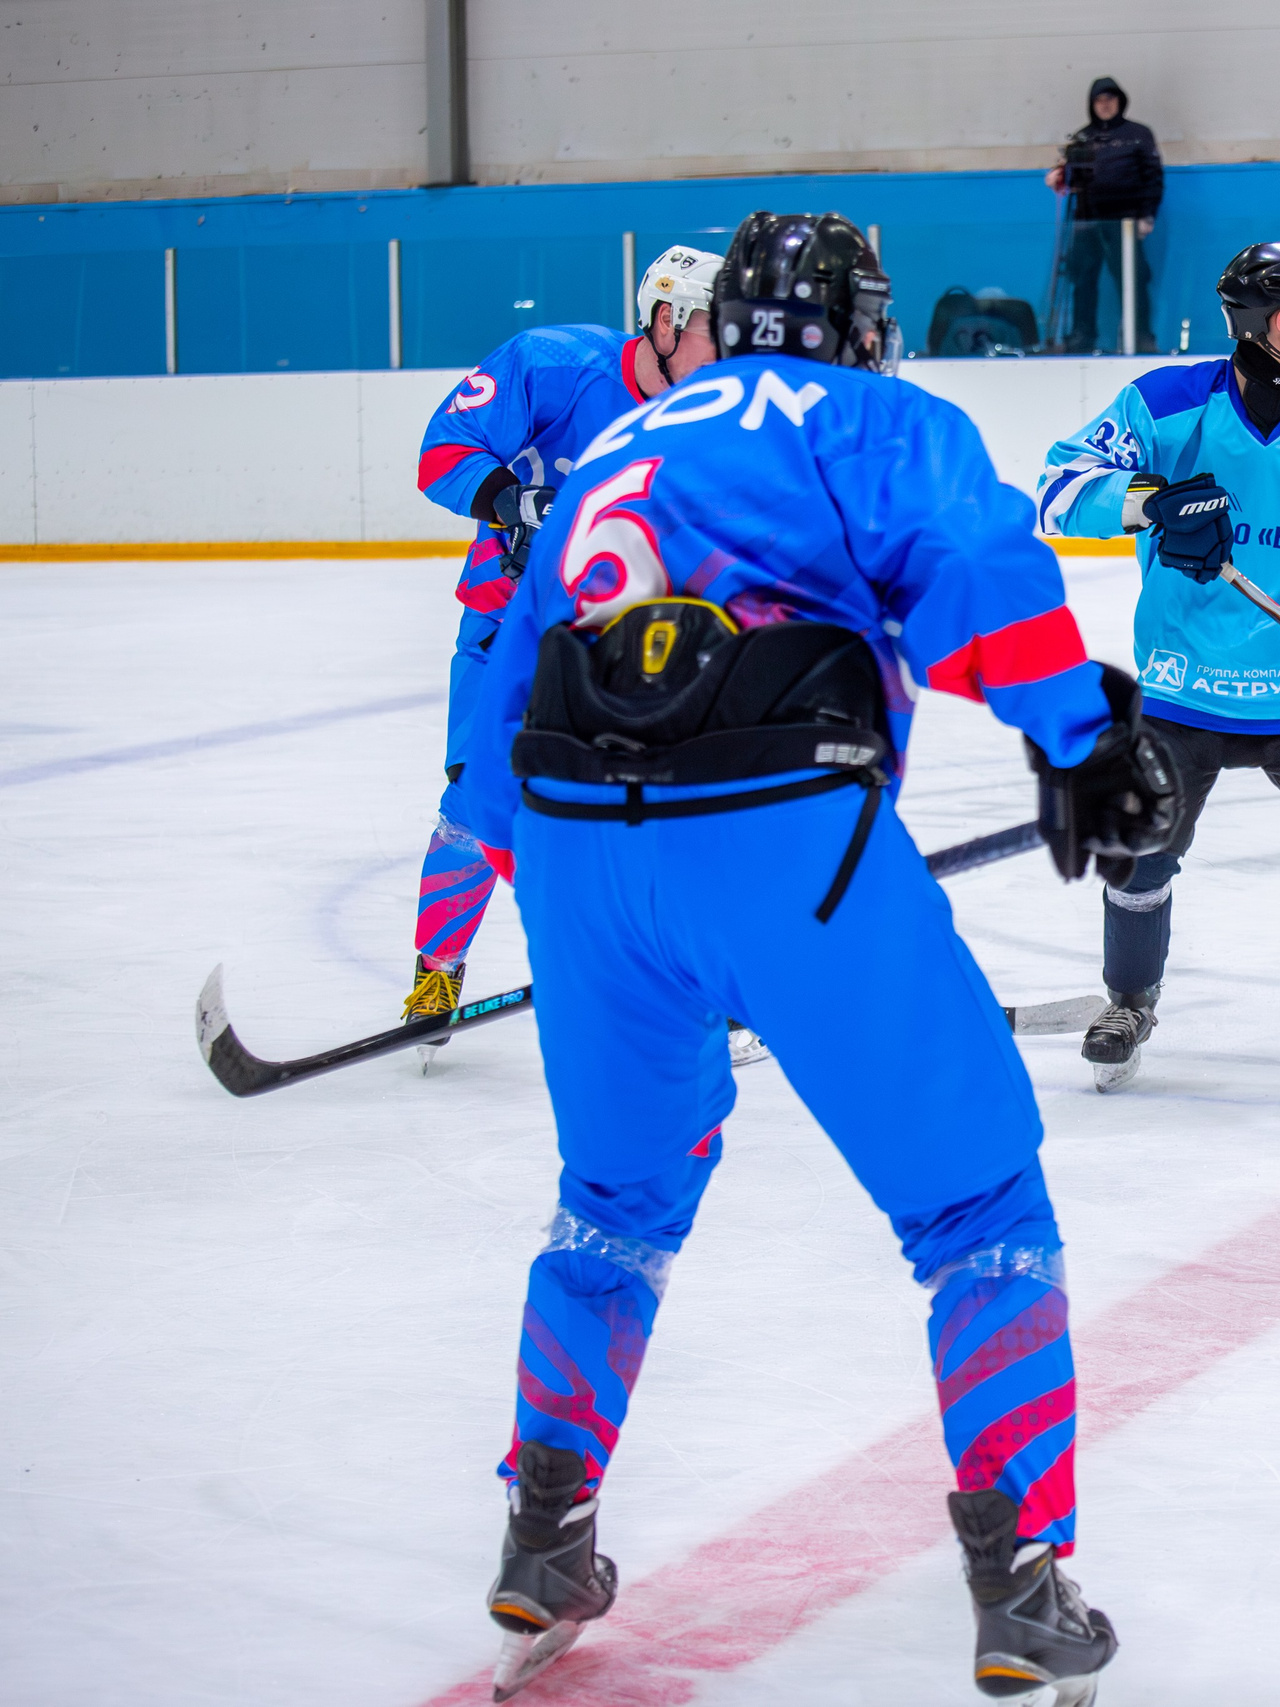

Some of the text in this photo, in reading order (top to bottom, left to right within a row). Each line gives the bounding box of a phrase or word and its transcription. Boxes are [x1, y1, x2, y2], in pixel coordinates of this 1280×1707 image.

[752, 310, 785, 347] 25
[1196, 664, 1239, 679] ГРУППА
[464, 1005, 478, 1019] BE
[480, 997, 501, 1014] LIKE
